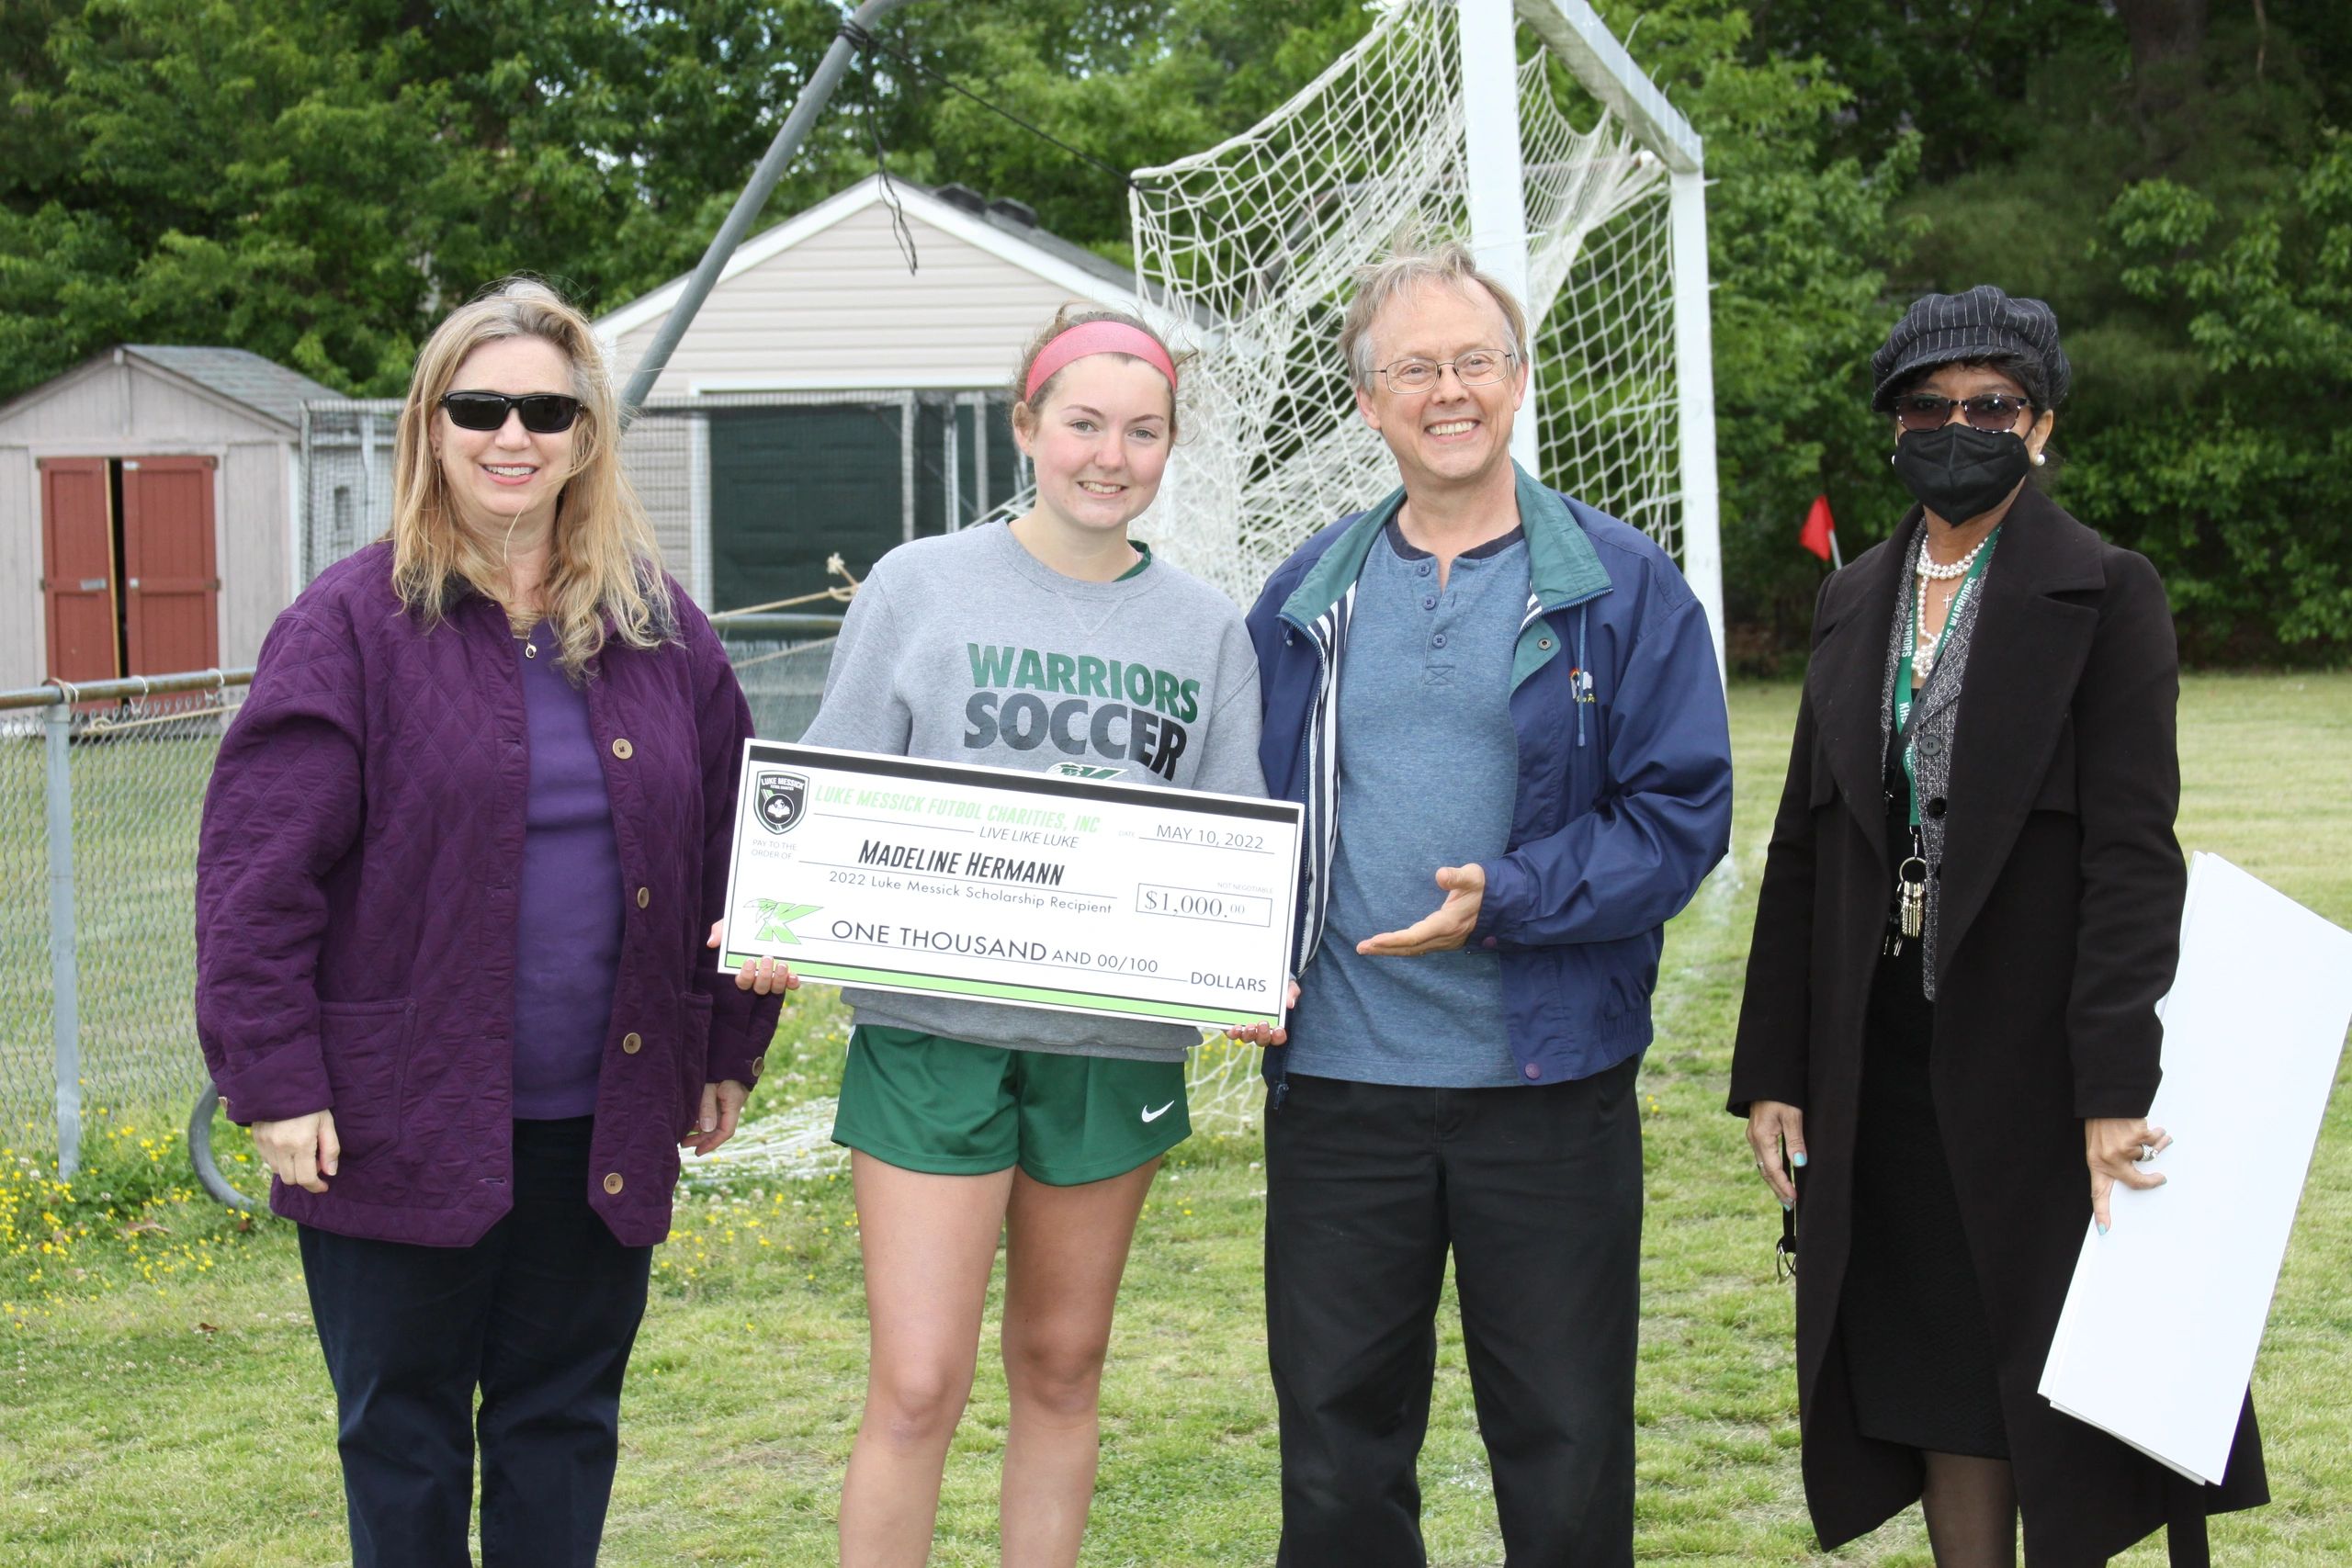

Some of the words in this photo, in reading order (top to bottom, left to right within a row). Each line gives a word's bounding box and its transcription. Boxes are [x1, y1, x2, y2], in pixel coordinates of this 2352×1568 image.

[967, 642, 1200, 724] WARRIORS
[963, 691, 1187, 782] SOCCER
[761, 777, 777, 785] LUKE
[777, 777, 804, 790] MESSICK
[814, 784, 854, 805] LUKE
[856, 789, 926, 813] MESSICK
[927, 797, 981, 820] FUTBOL
[987, 805, 1067, 831] CHARITIES,
[1073, 815, 1100, 833] INC
[752, 839, 766, 847] PAY
[770, 840, 780, 849] TO
[782, 842, 797, 851] THE
[979, 826, 1010, 840] LIVE
[1012, 829, 1041, 844] LIKE
[1043, 834, 1080, 849] LUKE
[1157, 824, 1193, 841] MAY
[1199, 829, 1220, 847] 10,
[1225, 832, 1263, 850] 2022
[751, 849, 779, 859] ORDER
[857, 839, 963, 874] MADELINE
[965, 852, 1066, 886] HERMANN
[829, 870, 865, 886] 2022
[871, 875, 901, 890] Luke
[907, 880, 960, 897] Messick
[966, 886, 1045, 908] Scholarship
[1050, 896, 1113, 914] Recipient
[1233, 884, 1273, 895] NEGOTIABLE
[831, 919, 890, 944] ONE
[899, 927, 1047, 962] THOUSAND
[1052, 949, 1091, 964] AND
[1097, 953, 1158, 973] 00/100
[1191, 971, 1267, 993] DOLLARS
